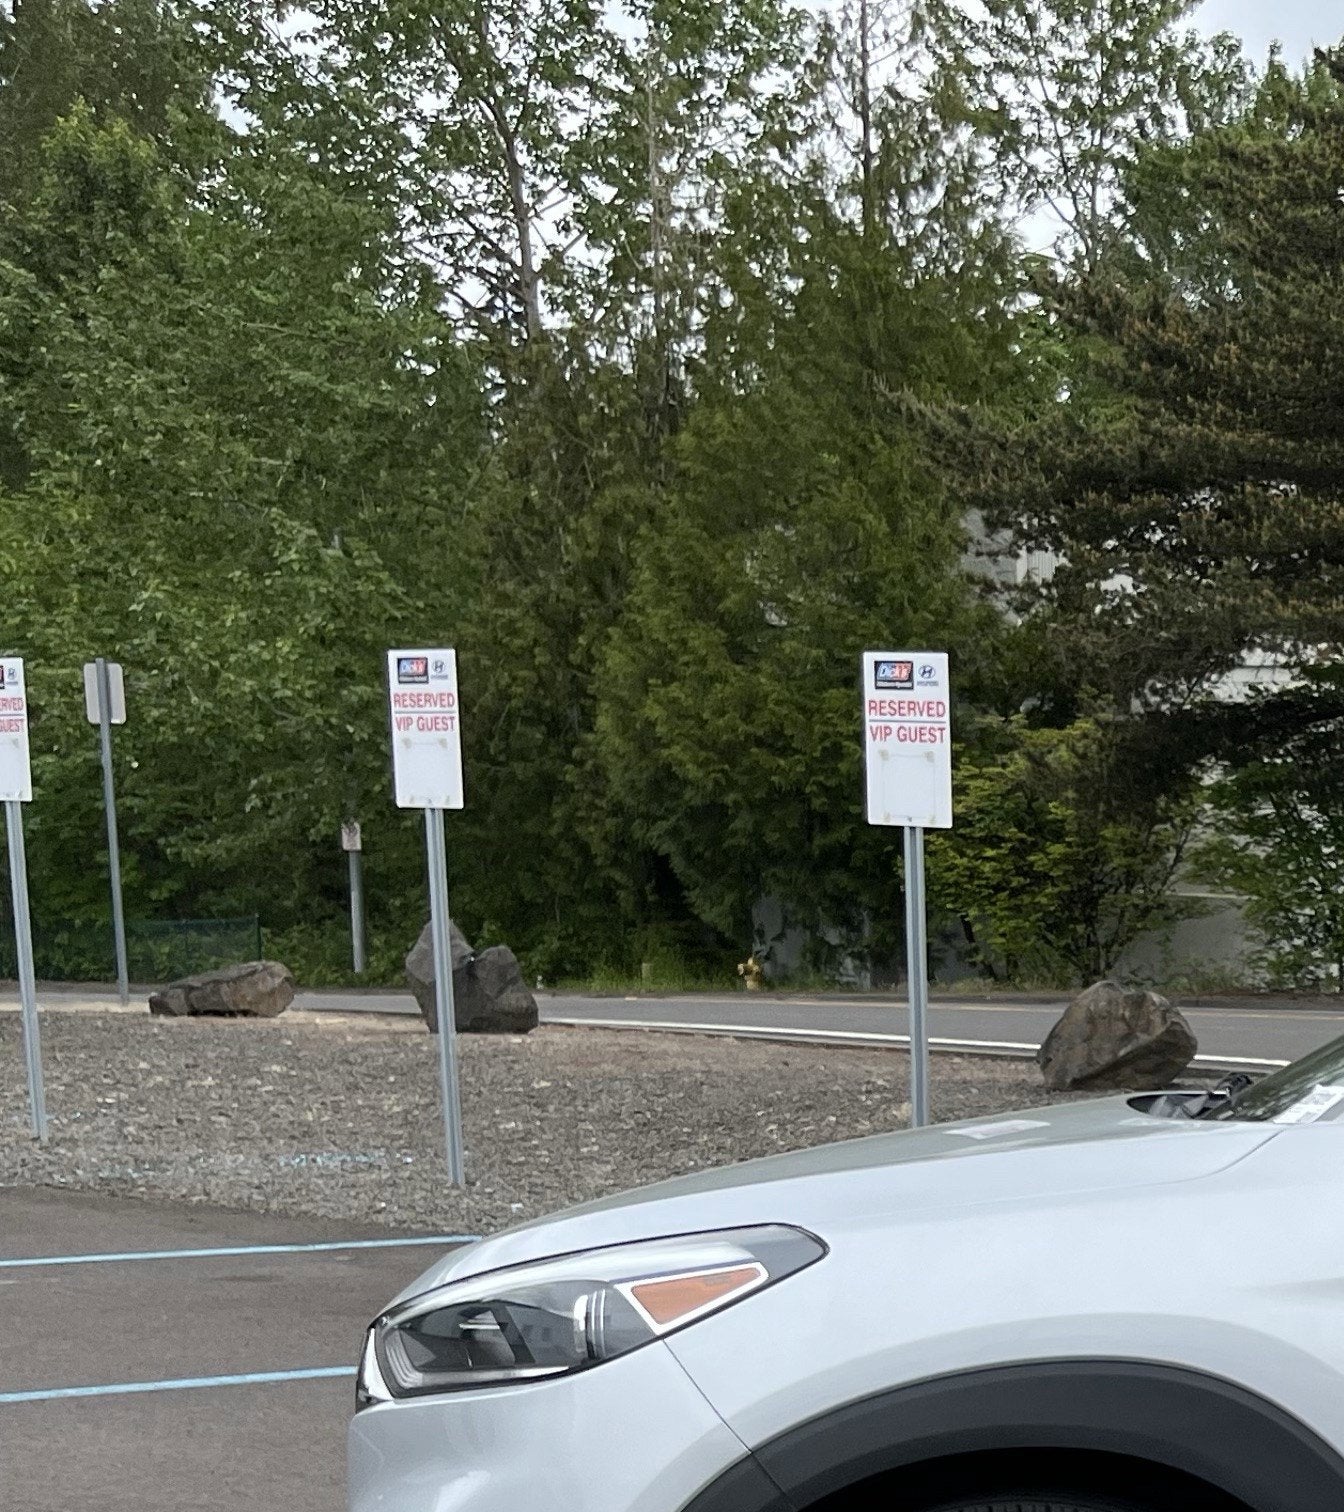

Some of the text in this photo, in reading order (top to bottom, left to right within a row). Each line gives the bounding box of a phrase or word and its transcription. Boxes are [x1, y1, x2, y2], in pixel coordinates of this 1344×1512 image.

[393, 692, 455, 708] RESERVED
[868, 699, 946, 718] RESERVED
[395, 716, 455, 732] VIP GUEST
[870, 725, 946, 744] VIP GUEST
